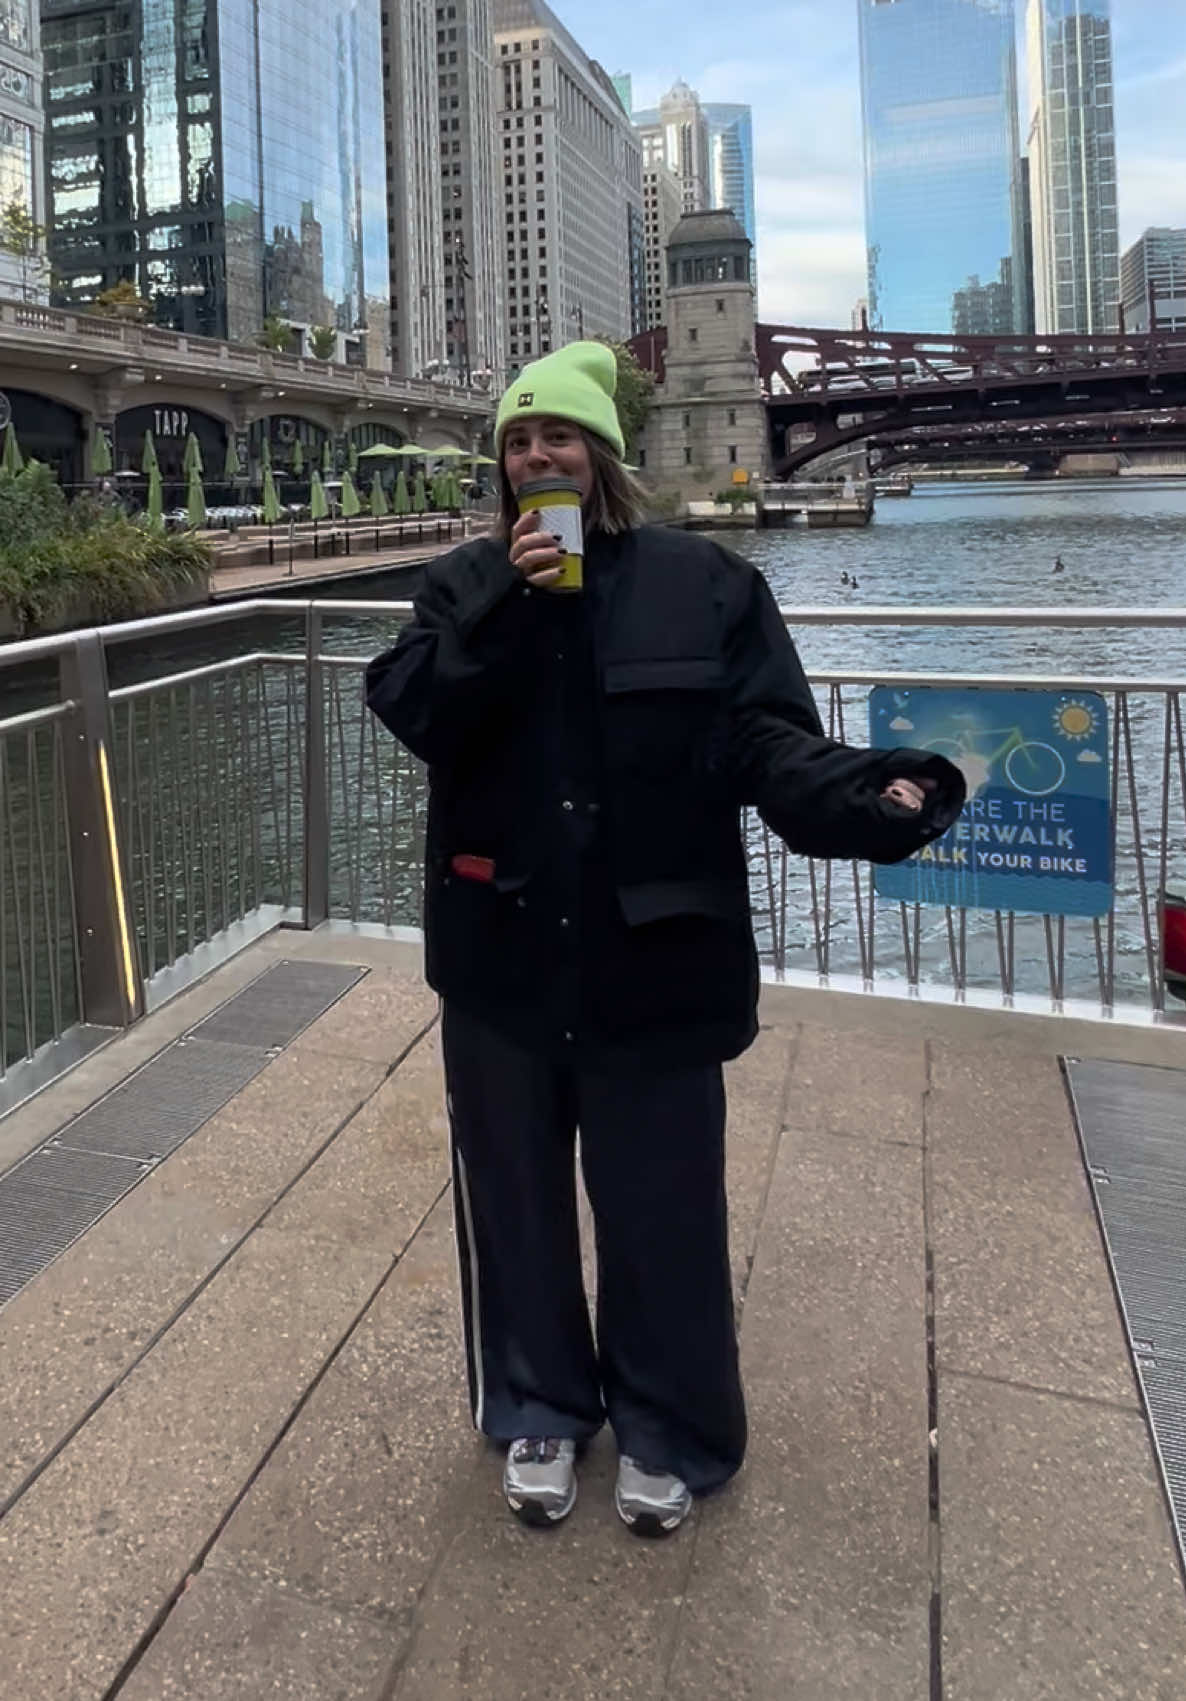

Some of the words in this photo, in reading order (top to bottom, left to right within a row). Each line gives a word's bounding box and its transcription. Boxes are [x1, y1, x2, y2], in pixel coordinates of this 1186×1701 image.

[154, 410, 188, 436] TAPP
[1012, 801, 1065, 822] THE
[977, 852, 1032, 869] YOUR
[1040, 856, 1088, 873] BIKE
